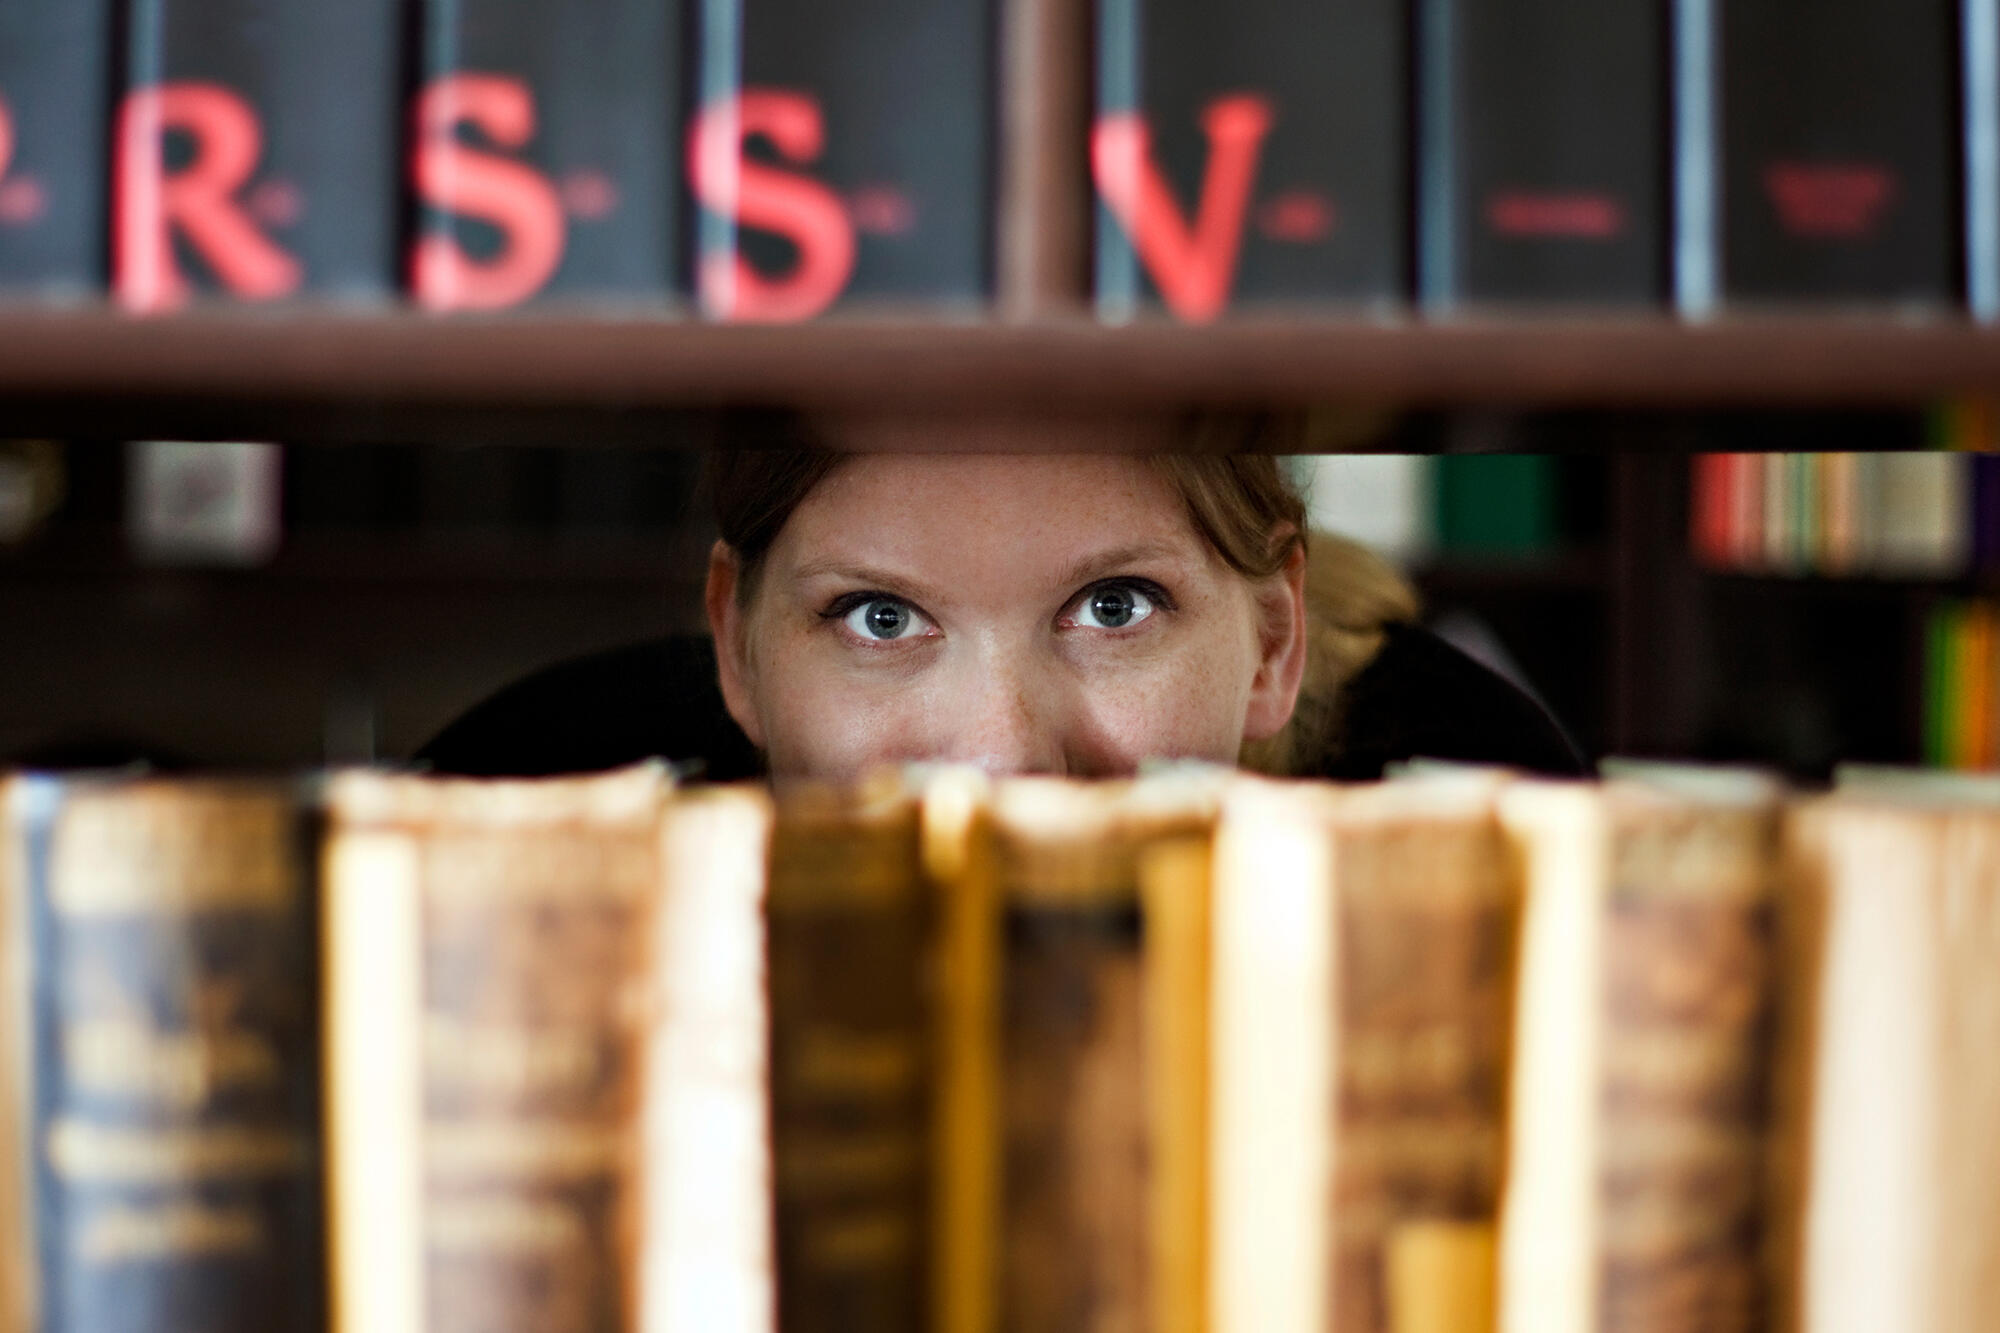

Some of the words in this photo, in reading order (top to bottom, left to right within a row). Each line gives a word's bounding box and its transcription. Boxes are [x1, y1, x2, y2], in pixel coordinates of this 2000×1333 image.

[115, 82, 300, 313] R
[411, 74, 563, 313] S
[690, 92, 855, 322] S
[1093, 95, 1272, 322] V
